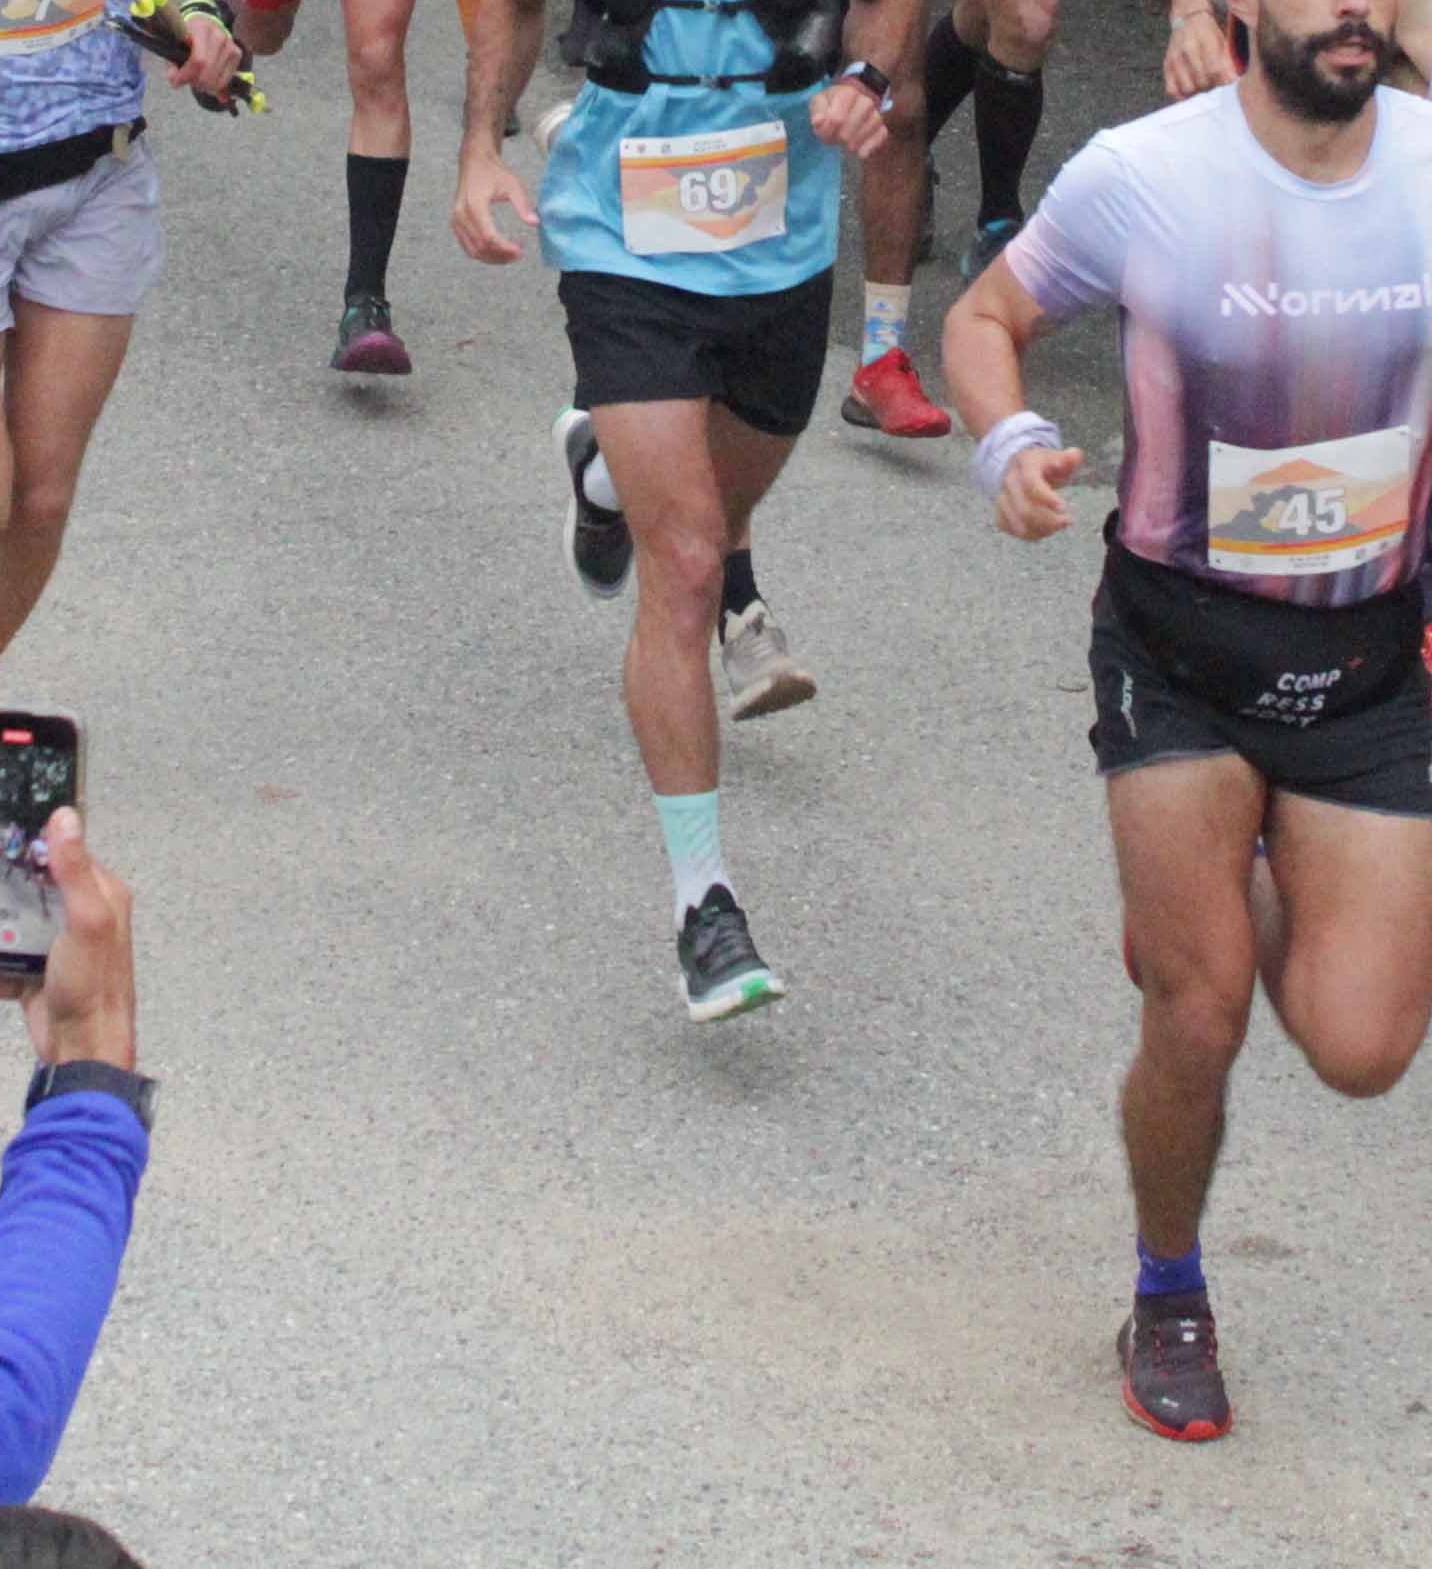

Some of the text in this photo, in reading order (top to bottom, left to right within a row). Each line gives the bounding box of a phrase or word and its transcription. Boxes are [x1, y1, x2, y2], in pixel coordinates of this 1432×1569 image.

[678, 167, 738, 213] 69
[1277, 485, 1348, 536] 45
[1276, 668, 1343, 693] COMP
[1256, 691, 1326, 712] RESS
